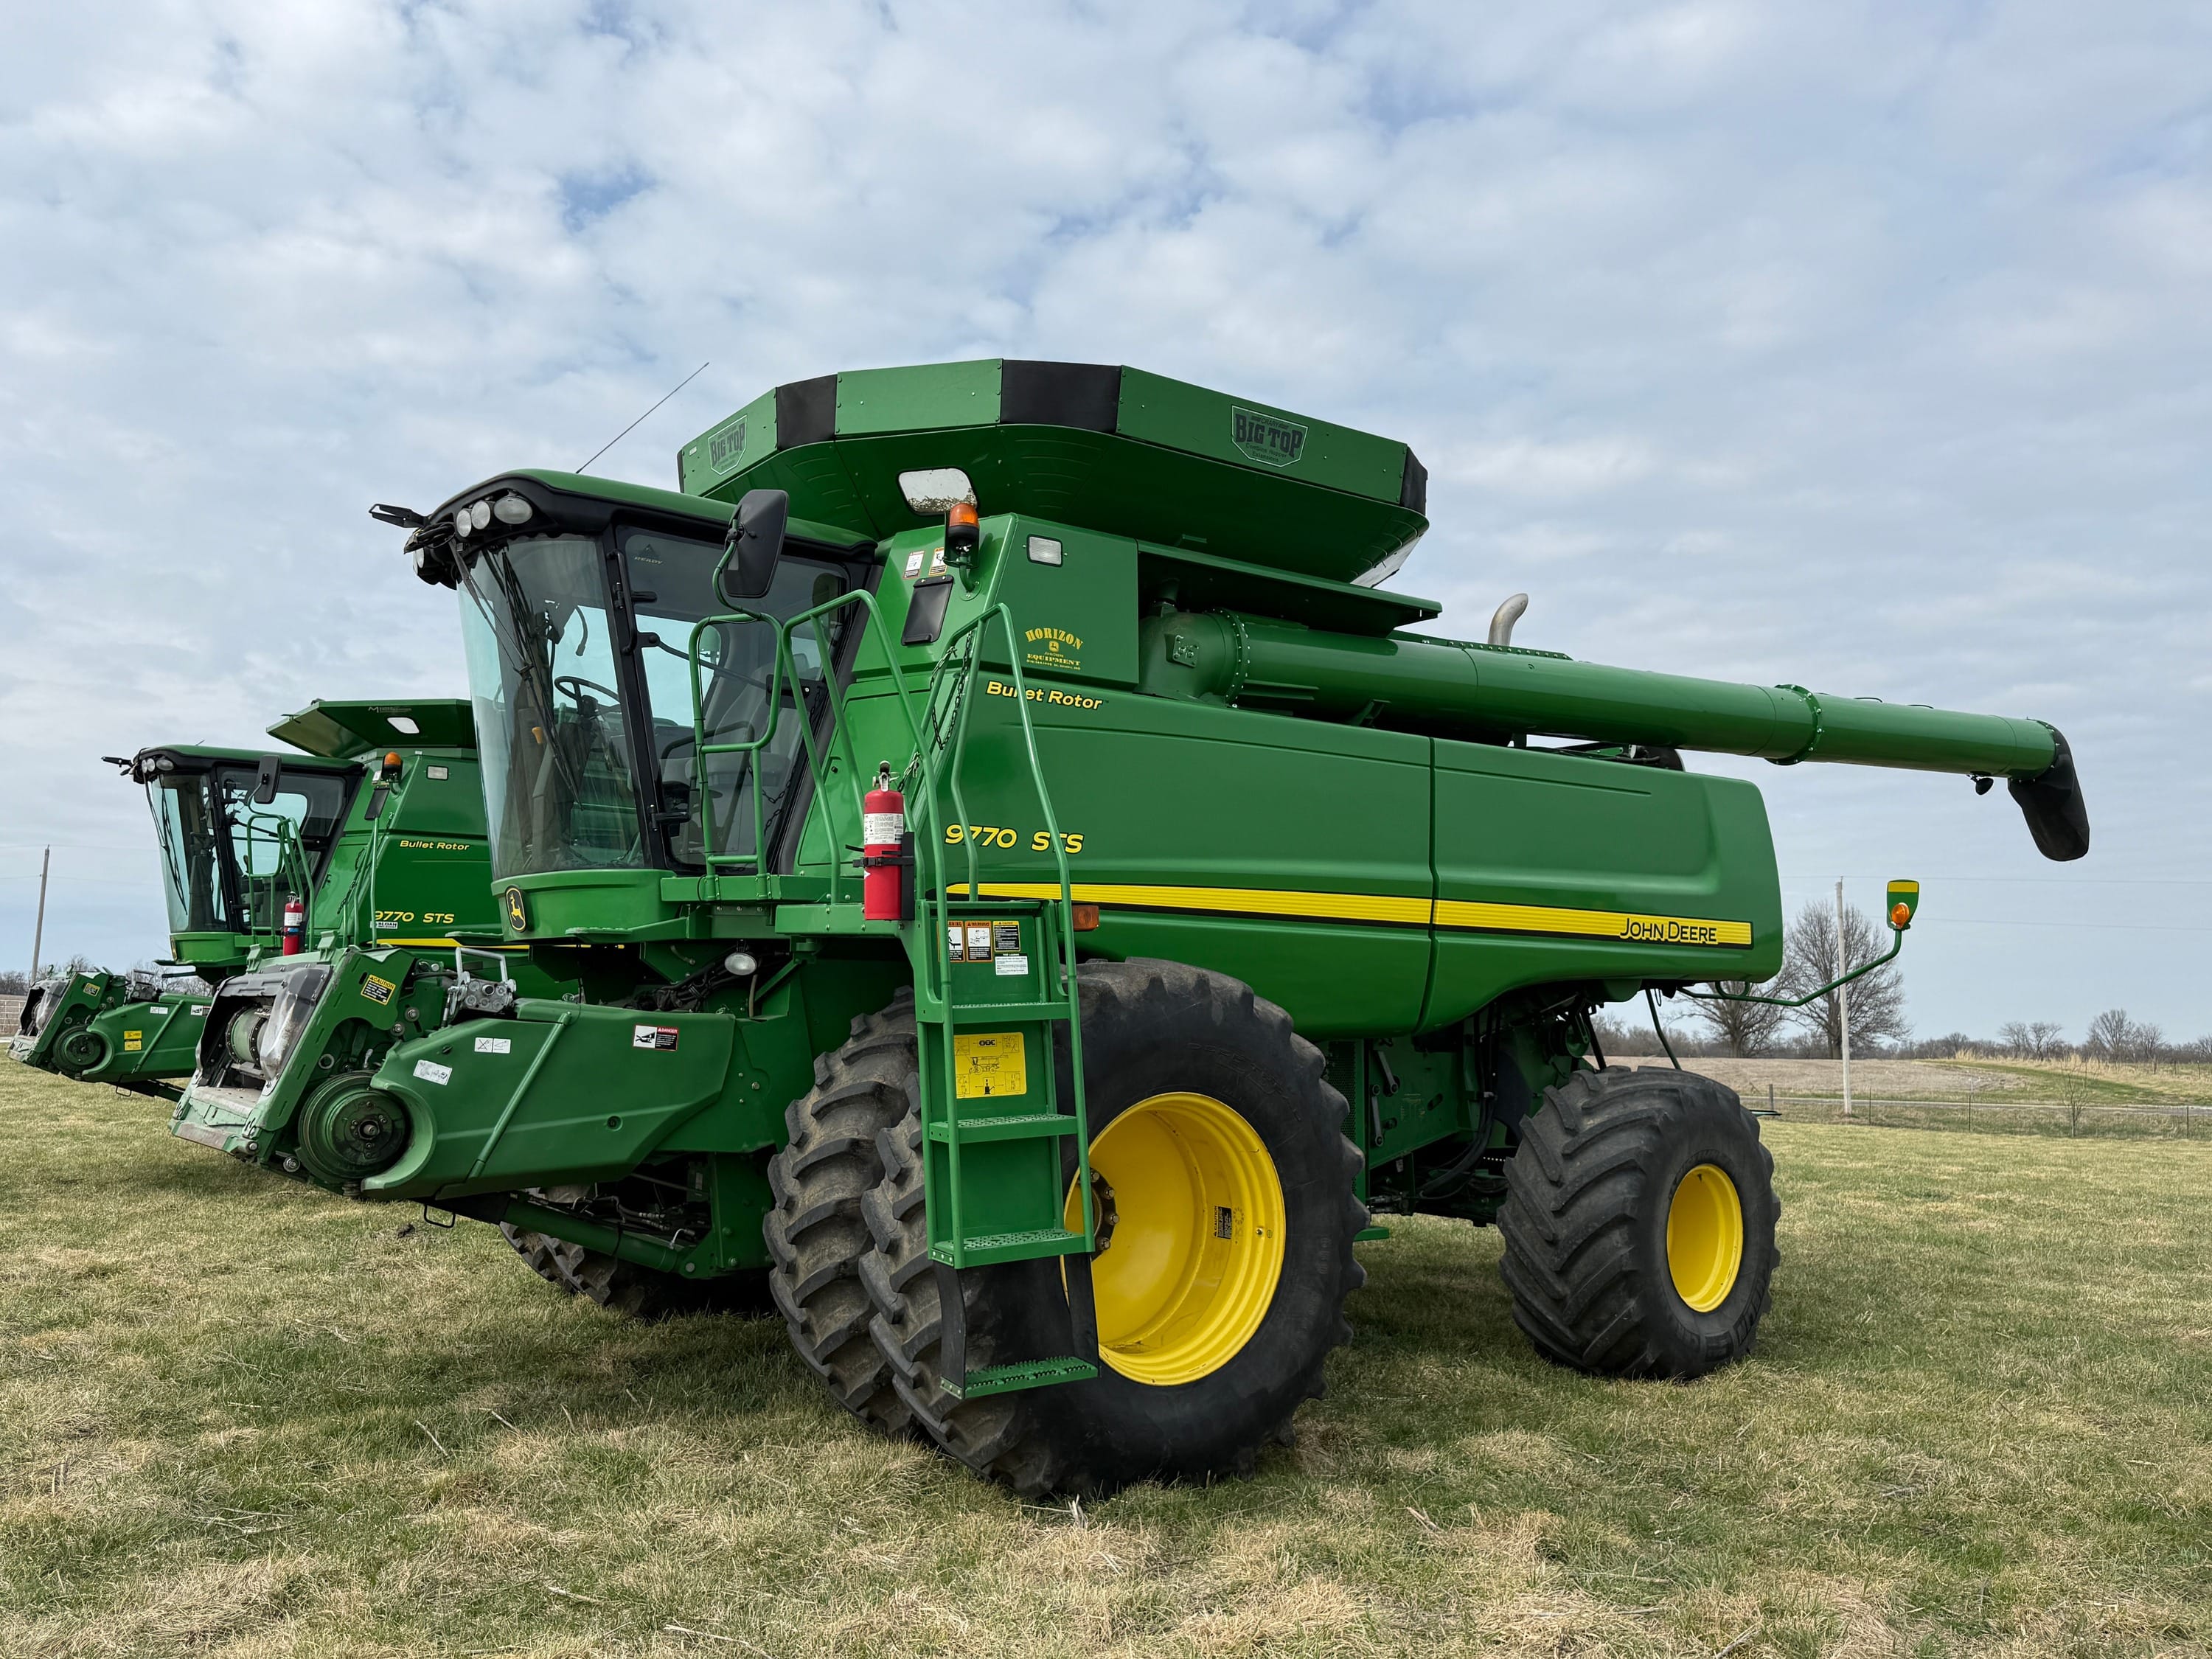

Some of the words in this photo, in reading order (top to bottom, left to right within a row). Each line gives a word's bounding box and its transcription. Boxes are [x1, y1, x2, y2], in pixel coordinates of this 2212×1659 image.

[710, 439, 726, 467] BIG
[727, 422, 745, 453] TOP
[1236, 414, 1265, 444] BIG
[1268, 428, 1303, 458] TOP
[1025, 627, 1084, 650] HORIZON
[1027, 653, 1081, 666] EQUIPMENT
[987, 681, 1045, 702] Buet
[1048, 690, 1102, 709] Rotor
[400, 840, 434, 849] Bullet
[437, 842, 470, 850] Rotor
[375, 911, 414, 922] 9770
[422, 913, 455, 924] STS
[1620, 918, 1664, 939] JOHN
[1668, 921, 1717, 942] DEERE
[373, 977, 394, 989] CAUTION
